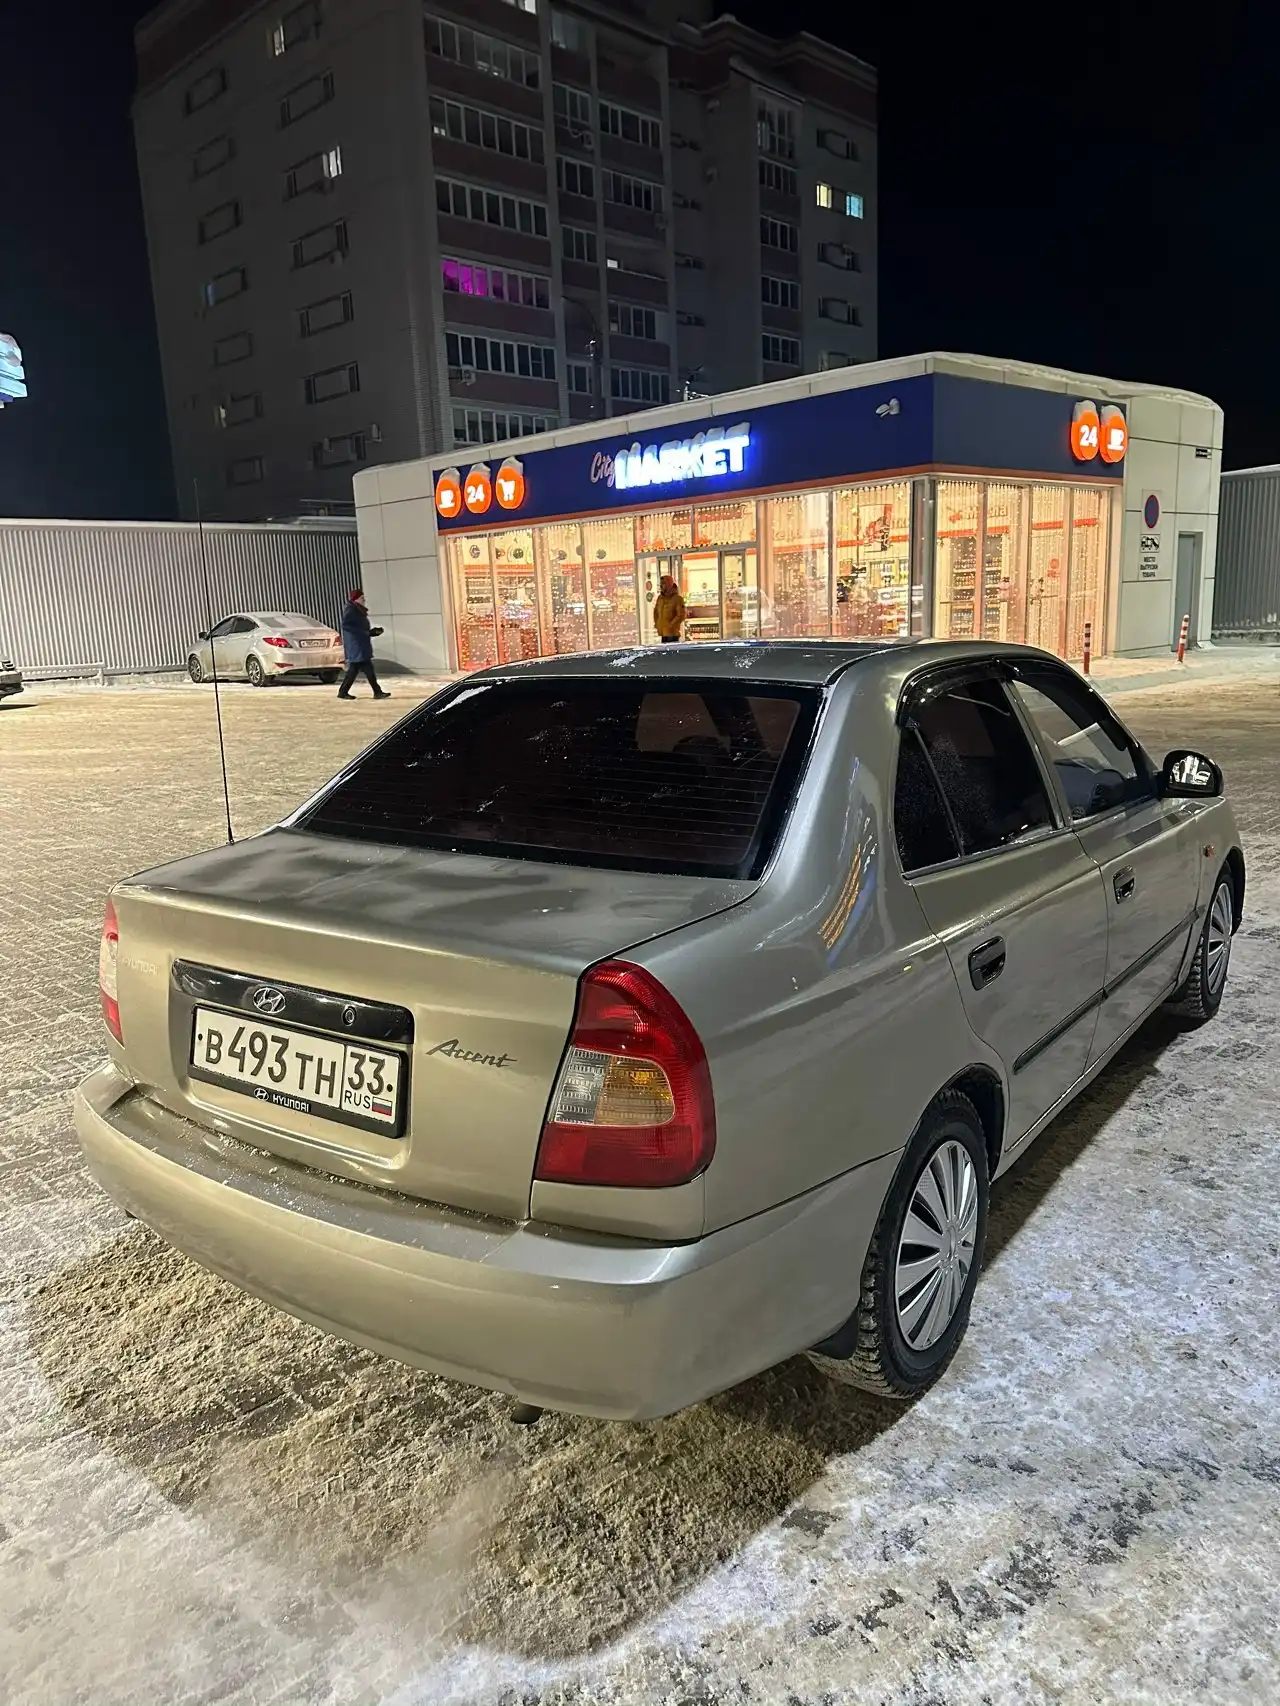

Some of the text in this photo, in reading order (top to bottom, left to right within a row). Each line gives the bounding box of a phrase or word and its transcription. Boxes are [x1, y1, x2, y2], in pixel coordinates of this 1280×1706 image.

[1080, 424, 1097, 447] 24
[591, 434, 749, 489] City MARKET
[467, 484, 485, 504] 24
[425, 1038, 518, 1068] Accent
[347, 1052, 387, 1096] 33
[272, 1094, 311, 1113] HYUNDAI
[344, 1090, 371, 1110] RUS
